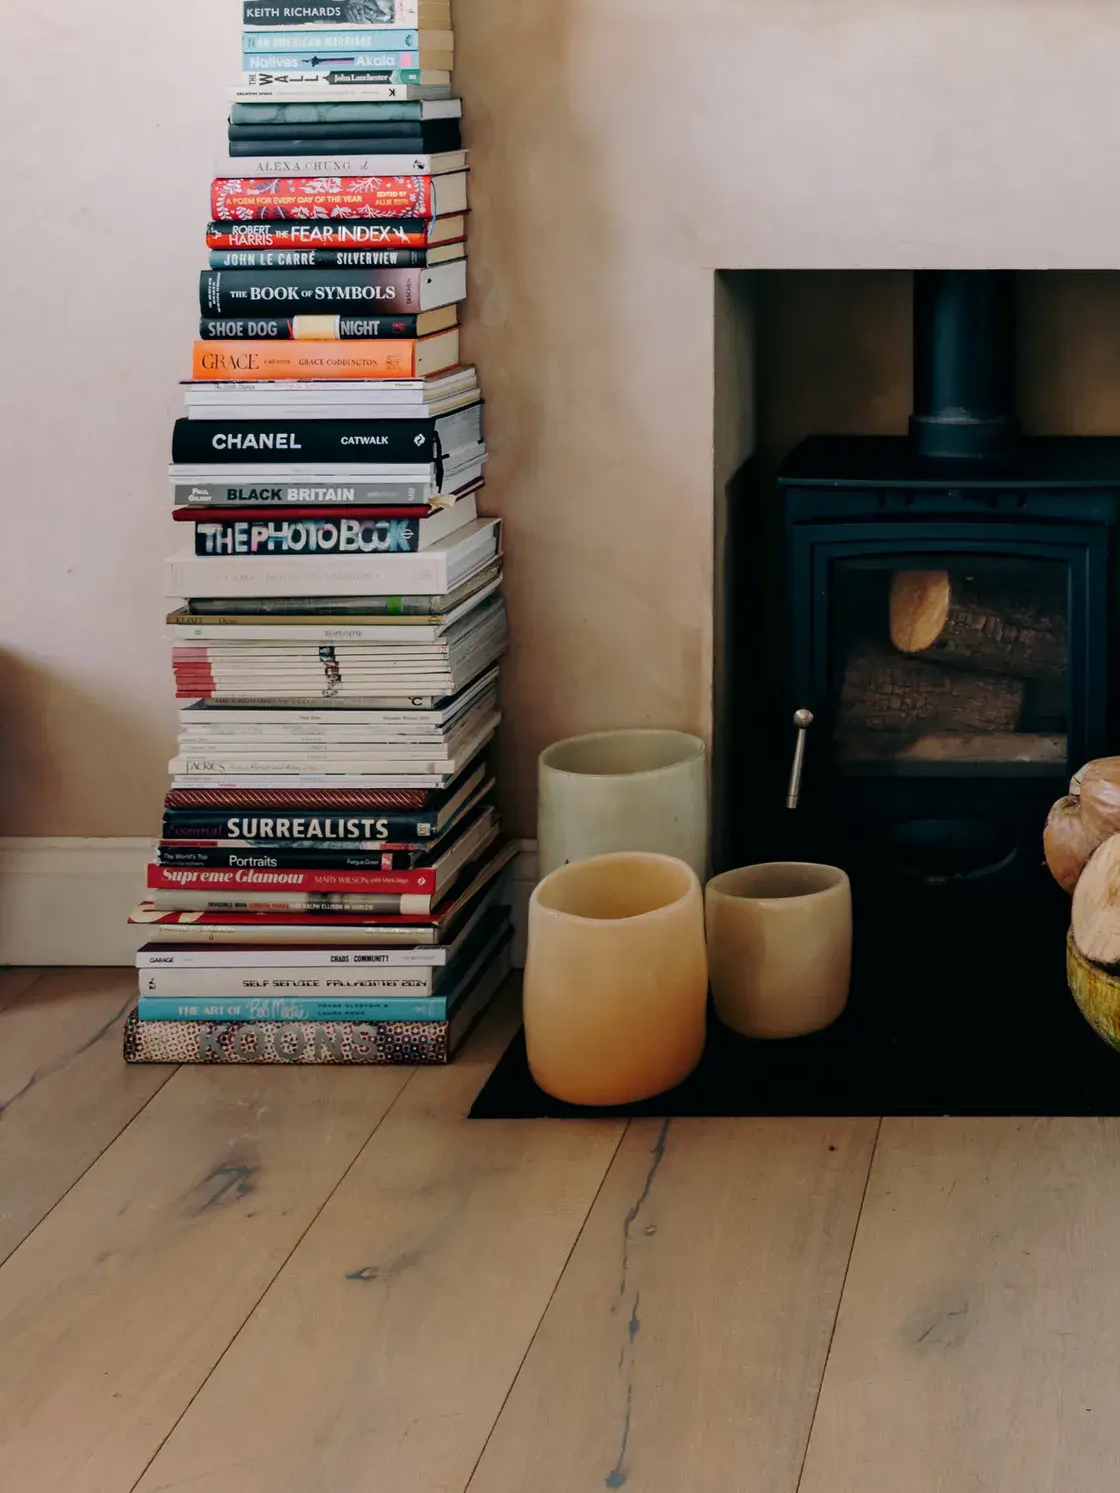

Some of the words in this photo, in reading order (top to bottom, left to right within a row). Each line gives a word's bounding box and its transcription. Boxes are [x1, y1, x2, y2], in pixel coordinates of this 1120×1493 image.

[246, 8, 280, 17] KEITH
[283, 7, 341, 17] RICHARDS
[249, 57, 298, 68] Natives
[355, 55, 395, 66] Akala
[334, 73, 350, 83] John
[350, 73, 388, 82] Lanchester
[256, 161, 301, 171] ALEXA
[304, 161, 351, 171] CHUNG
[232, 197, 255, 205] POEM
[256, 197, 272, 205] FOR
[273, 197, 297, 205] EVERY
[297, 196, 314, 204] DAY
[314, 196, 327, 204] OF
[327, 195, 342, 203] THE
[342, 195, 363, 203] YEAR
[232, 225, 271, 235] ROBERT
[275, 230, 289, 239] THE
[290, 225, 333, 243] FEAR
[337, 225, 391, 242] INDEX
[228, 234, 273, 246] HARRIS
[224, 253, 256, 266] JOHN
[260, 253, 273, 266] LE
[277, 250, 316, 265] CARRÉ
[336, 252, 398, 265] SILVERVIEW
[230, 290, 248, 298] THE
[250, 286, 300, 301] BOOK
[301, 290, 313, 298] OF
[314, 286, 396, 300] SYMBOLS
[208, 321, 244, 337] SHOE
[250, 321, 278, 336] DOG
[340, 320, 380, 336] NIGHT
[201, 353, 259, 370] GRACE
[298, 358, 325, 366] GRACE
[212, 433, 302, 449] CHANEL
[340, 436, 389, 445] CATWALK
[226, 488, 283, 501] BLACK
[287, 488, 354, 501] BRITAIN
[197, 522, 249, 554] THE
[227, 817, 389, 839] SURREALISTS
[229, 855, 277, 867] Portraits
[161, 868, 233, 885] Supreme
[235, 868, 305, 885] Glamour
[314, 876, 336, 884] MARY
[338, 877, 370, 885] WILSON
[330, 955, 350, 963] CHAOS
[242, 979, 269, 987] SELF
[272, 979, 320, 987] SERVICE
[178, 1005, 199, 1015] THE
[204, 1006, 224, 1015] ART
[228, 1006, 241, 1015] OF
[196, 1024, 378, 1060] KOONS
